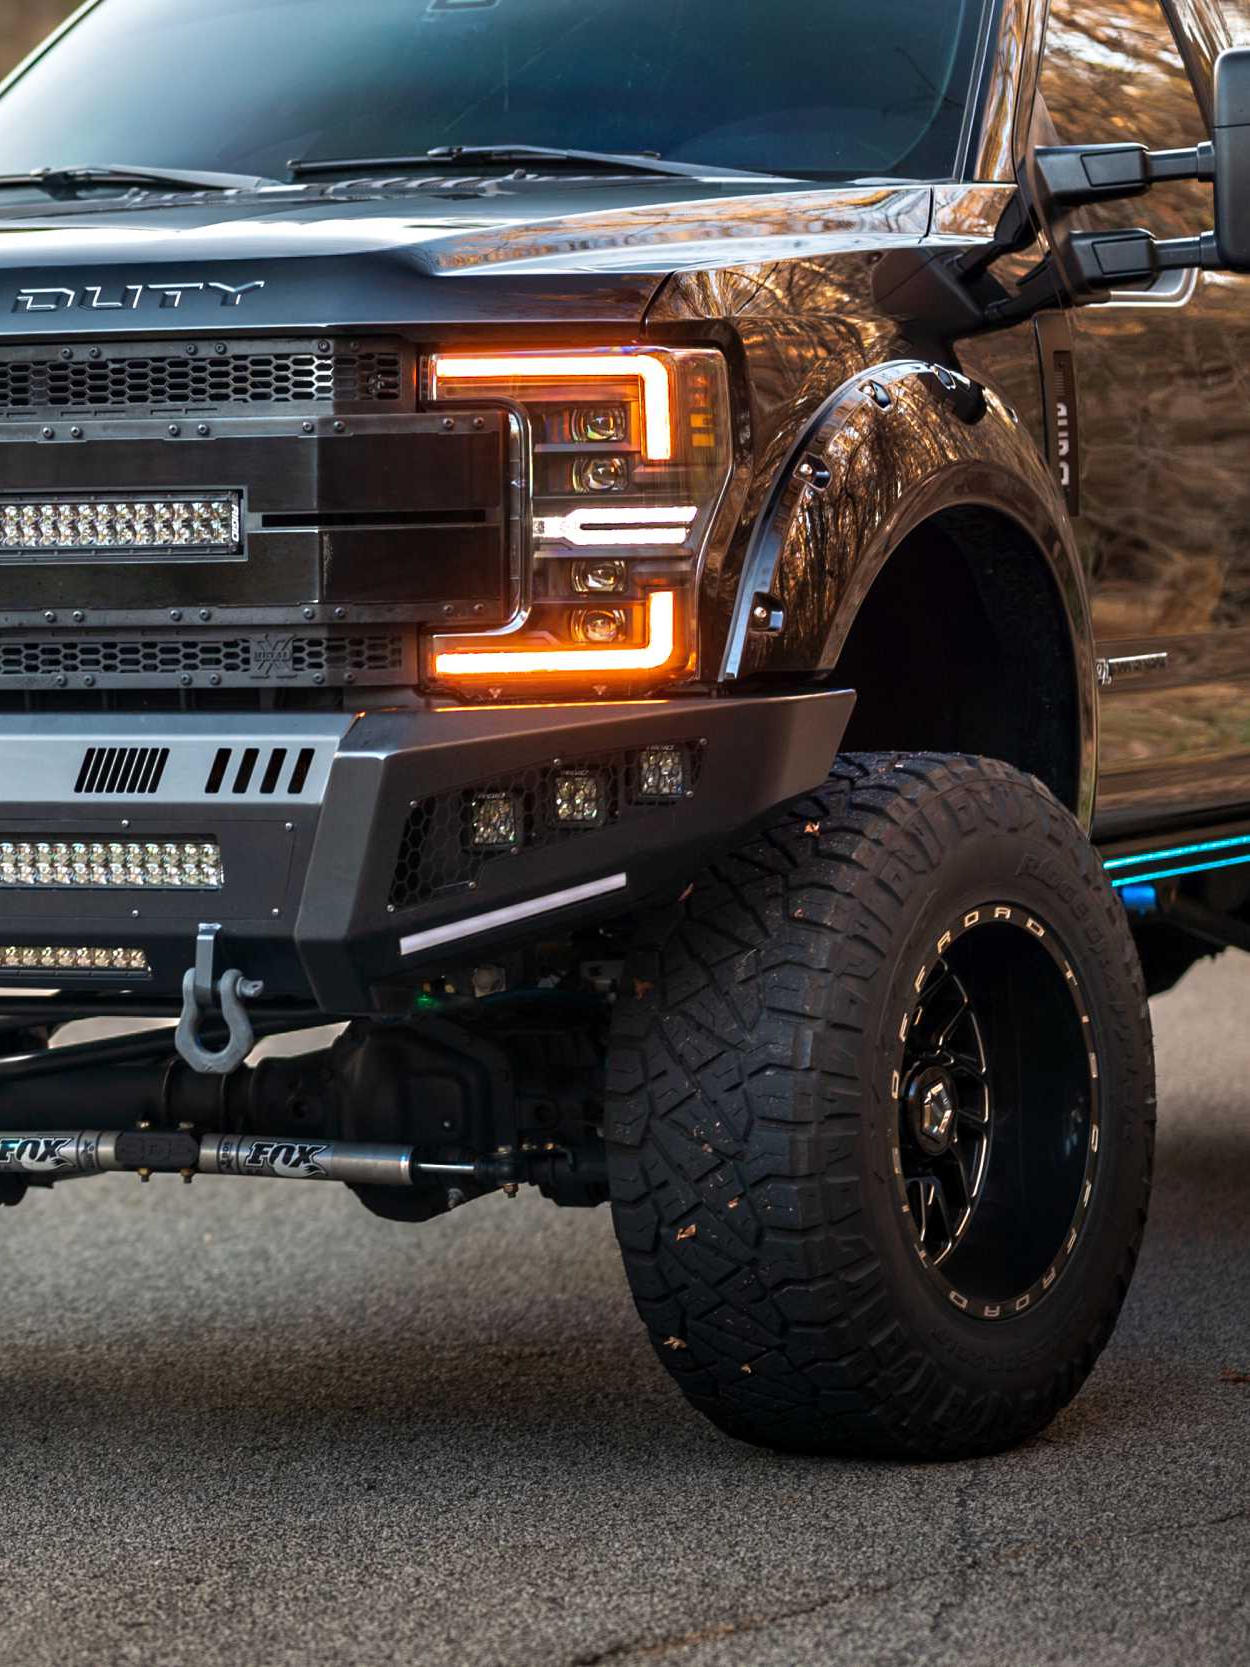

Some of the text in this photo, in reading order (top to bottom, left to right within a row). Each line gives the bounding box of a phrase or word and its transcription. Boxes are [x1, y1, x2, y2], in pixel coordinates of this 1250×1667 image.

[11, 281, 265, 313] DUTY
[231, 504, 239, 542] RIGID
[245, 1141, 328, 1174] FOX
